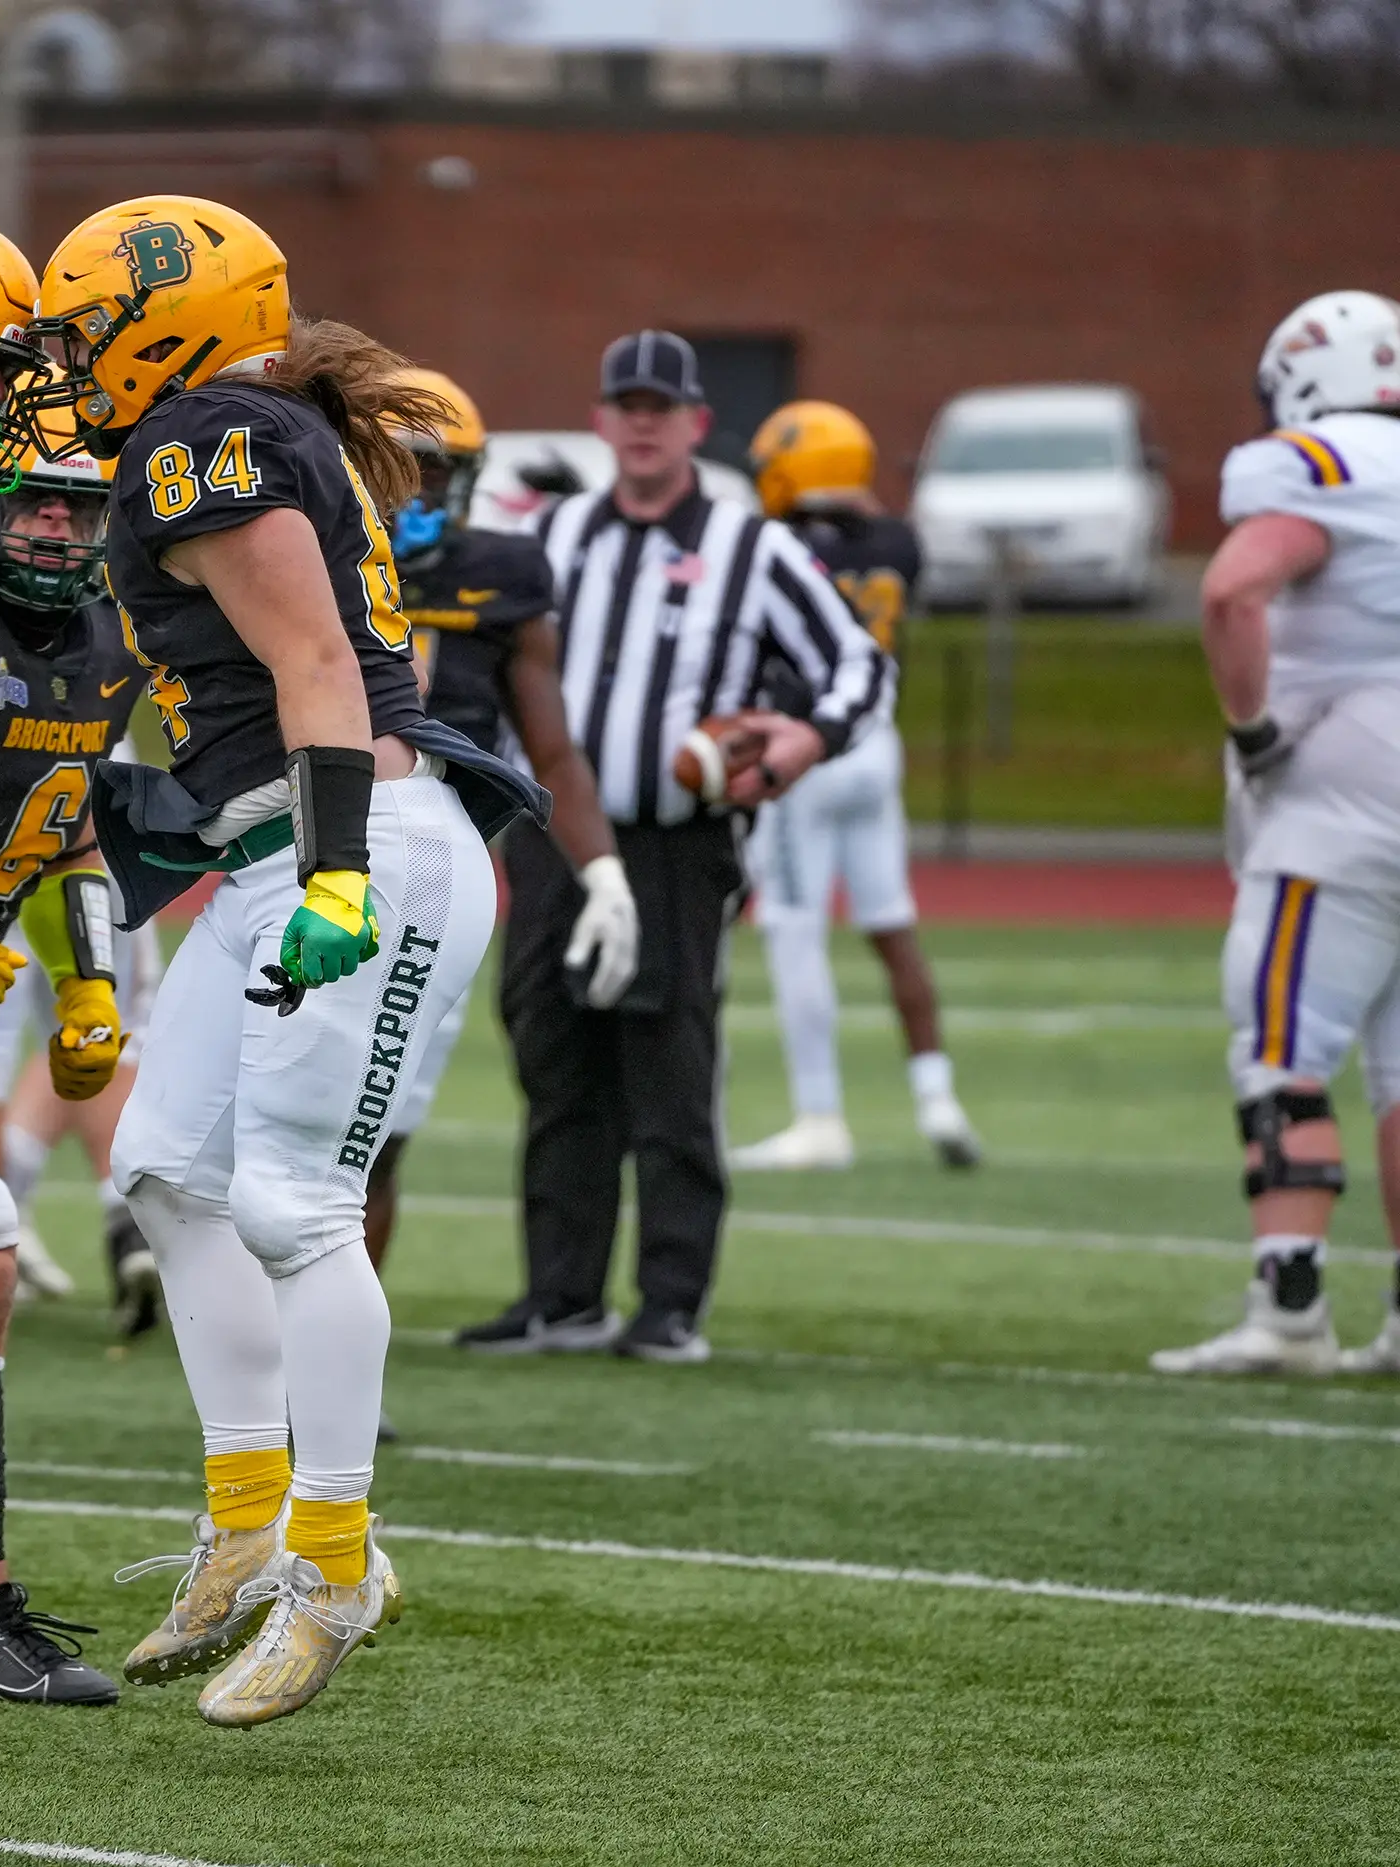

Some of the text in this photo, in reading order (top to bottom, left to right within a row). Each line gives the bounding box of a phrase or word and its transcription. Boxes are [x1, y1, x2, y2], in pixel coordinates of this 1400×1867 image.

[146, 426, 262, 522] 84
[3, 717, 111, 754] BROCKPORT
[337, 925, 439, 1172] BROCKPORT
